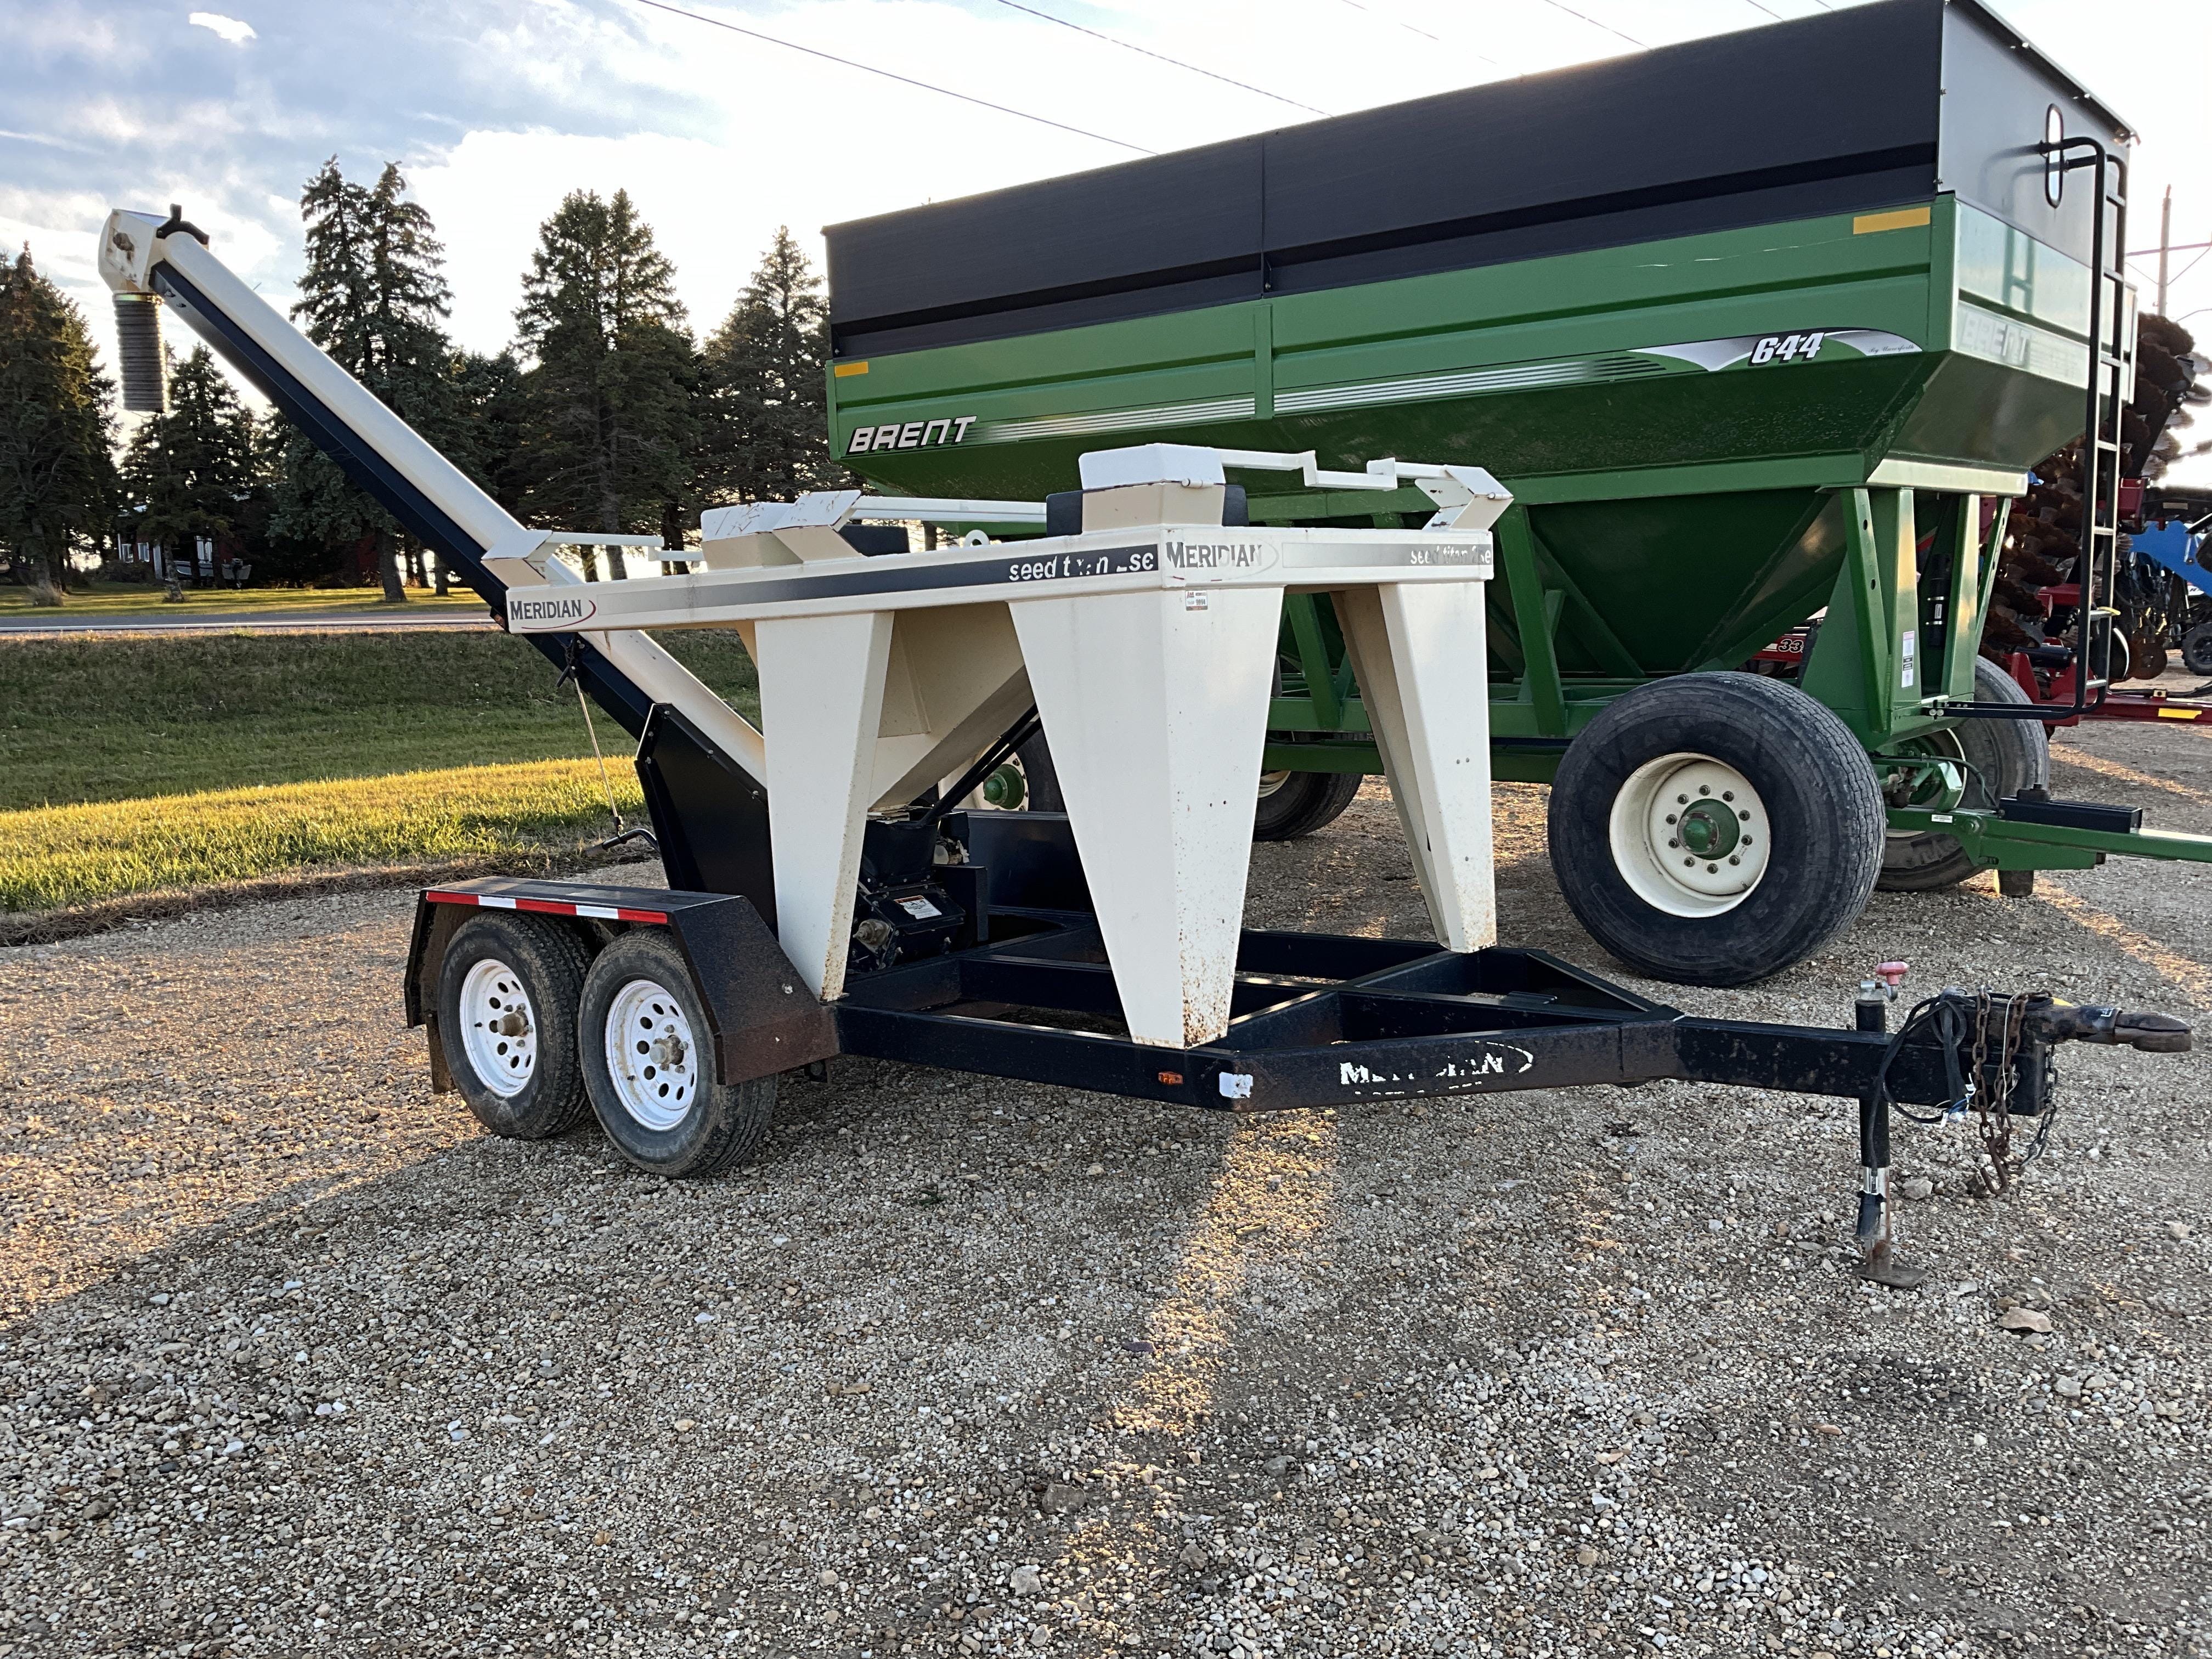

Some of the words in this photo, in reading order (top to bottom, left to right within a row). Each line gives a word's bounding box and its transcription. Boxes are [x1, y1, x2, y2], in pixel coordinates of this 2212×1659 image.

[1750, 332, 1824, 364] 644
[846, 415, 977, 454] BRENT
[1009, 556, 1057, 581] seed
[510, 599, 583, 620] MERIDIAN
[1779, 639, 1804, 653] 33
